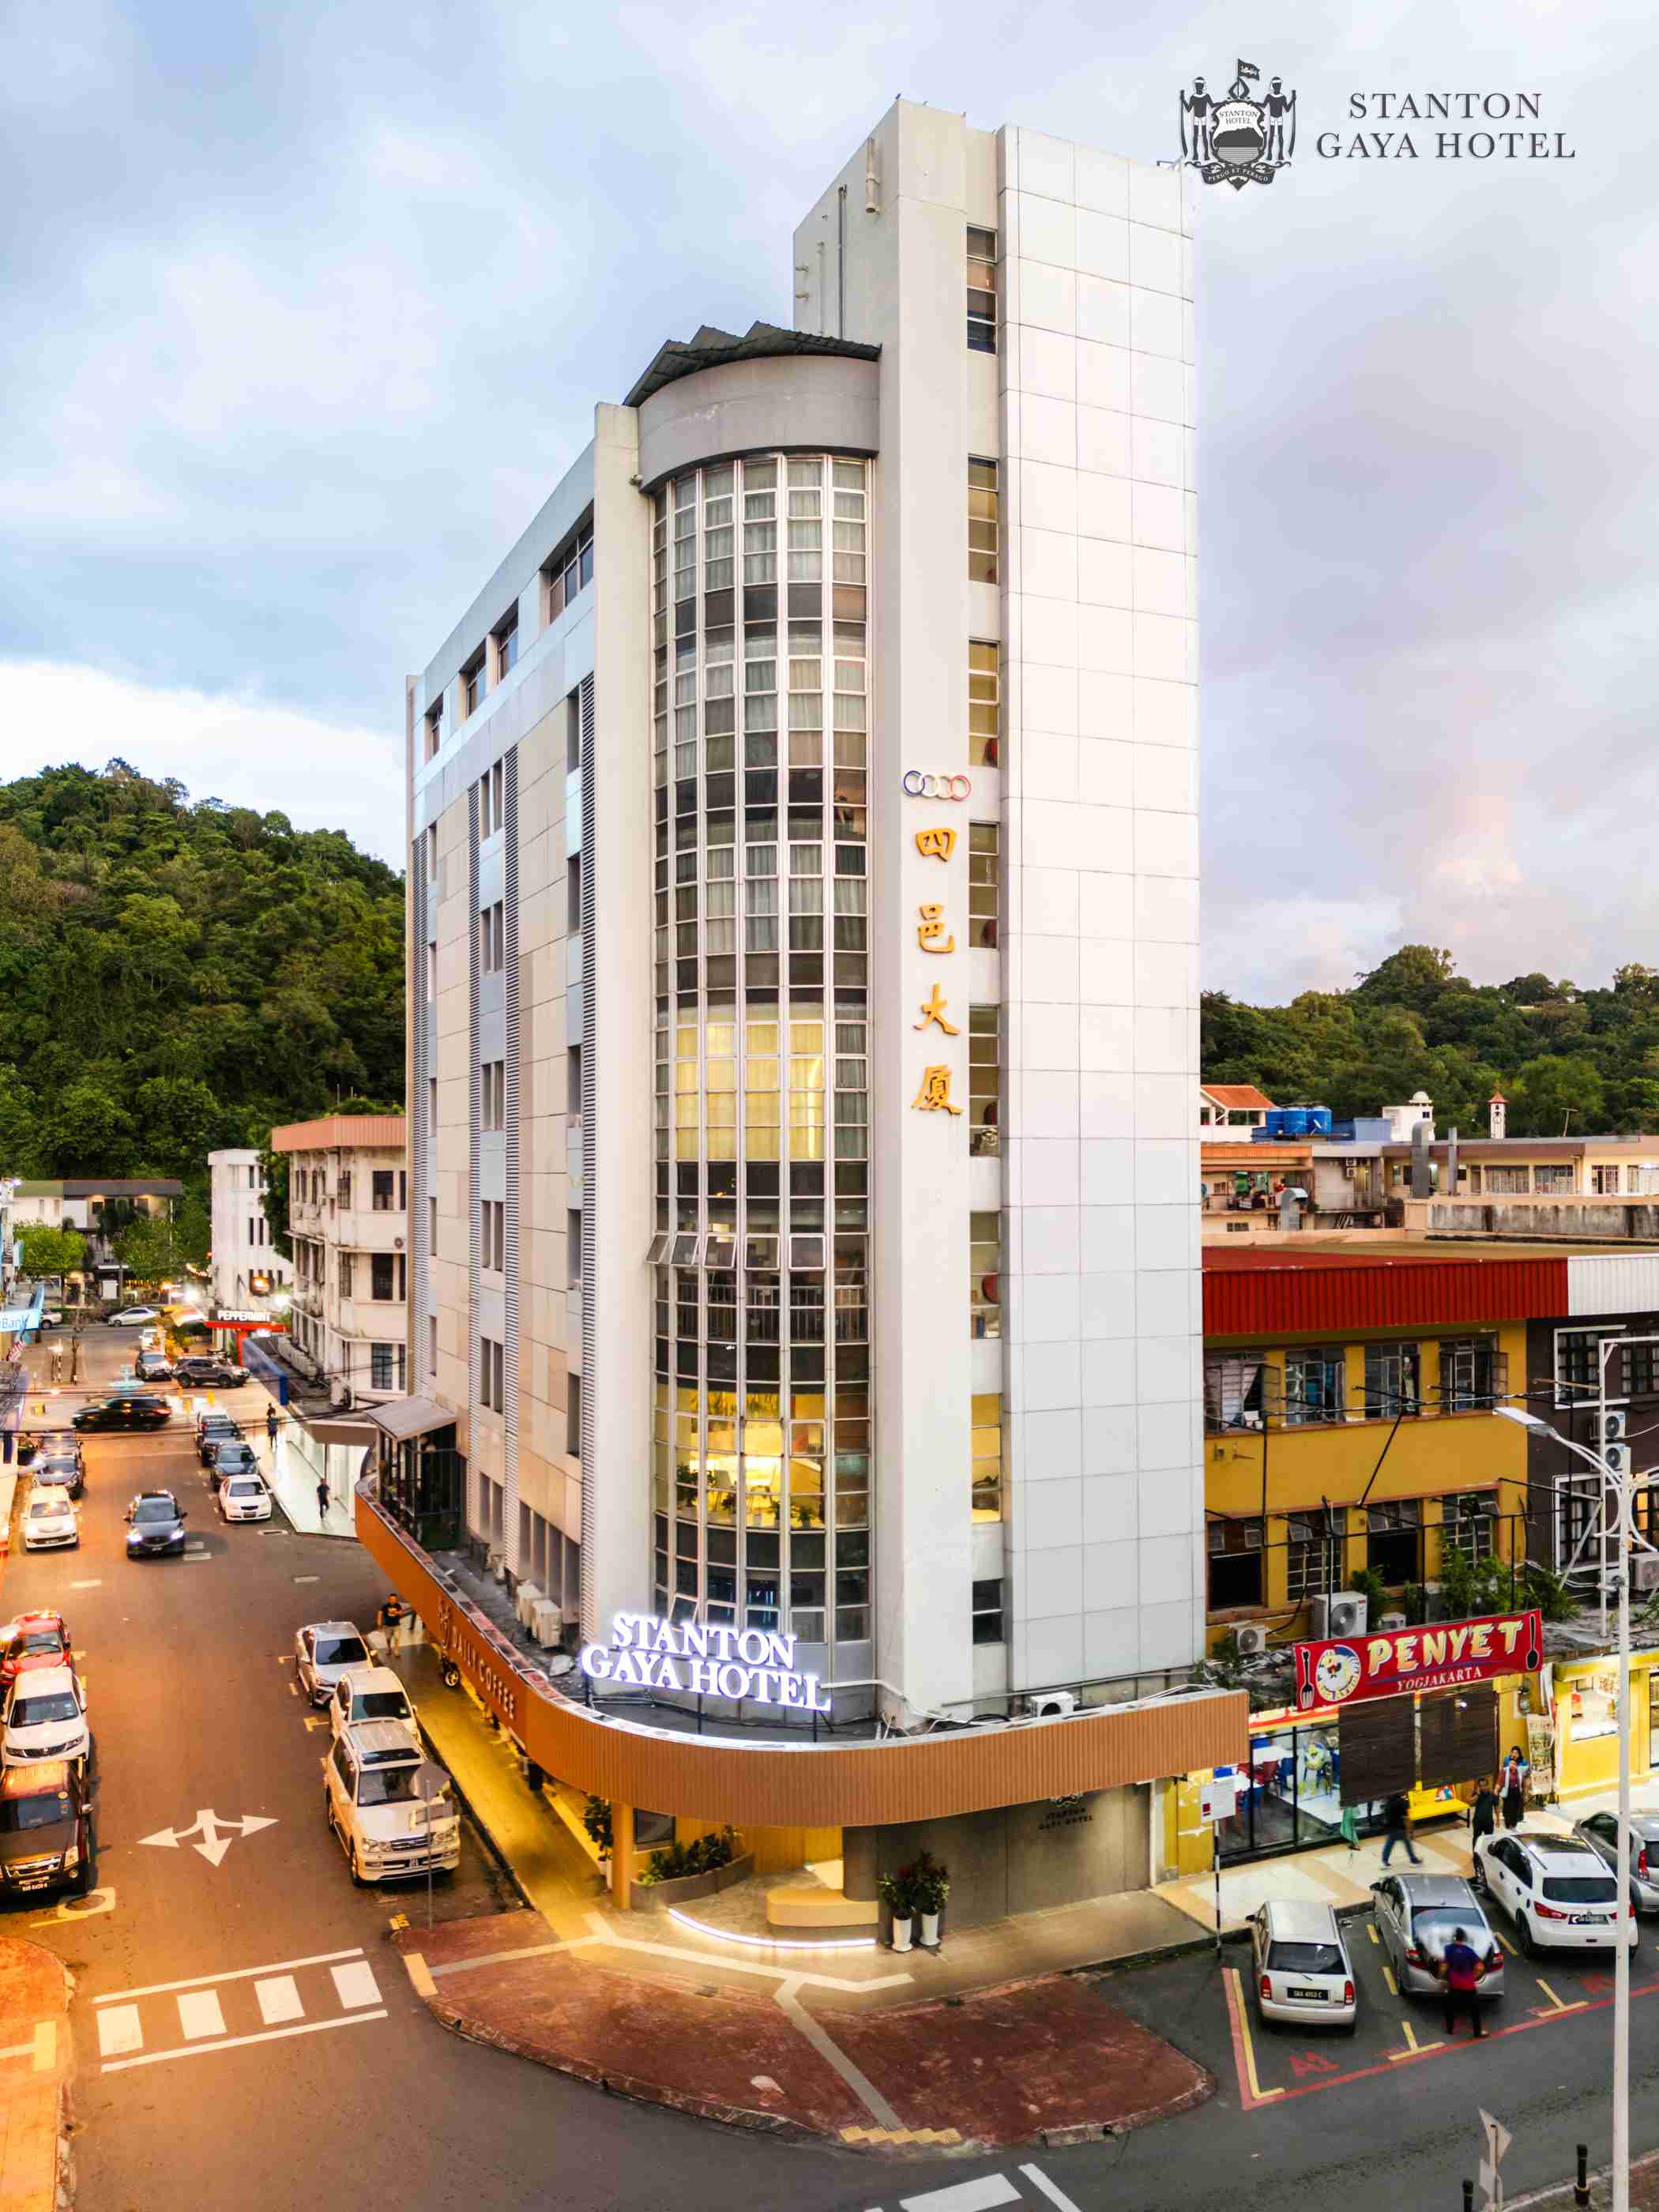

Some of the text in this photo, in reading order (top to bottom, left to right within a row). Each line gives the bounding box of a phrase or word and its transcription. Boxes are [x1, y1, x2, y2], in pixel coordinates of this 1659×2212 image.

[612, 1614, 797, 1668] STANTON
[1367, 1620, 1523, 1676] PENYET
[581, 1645, 831, 1711] GAYA HOTEL
[1397, 1665, 1483, 1692] YOGJAKARTA
